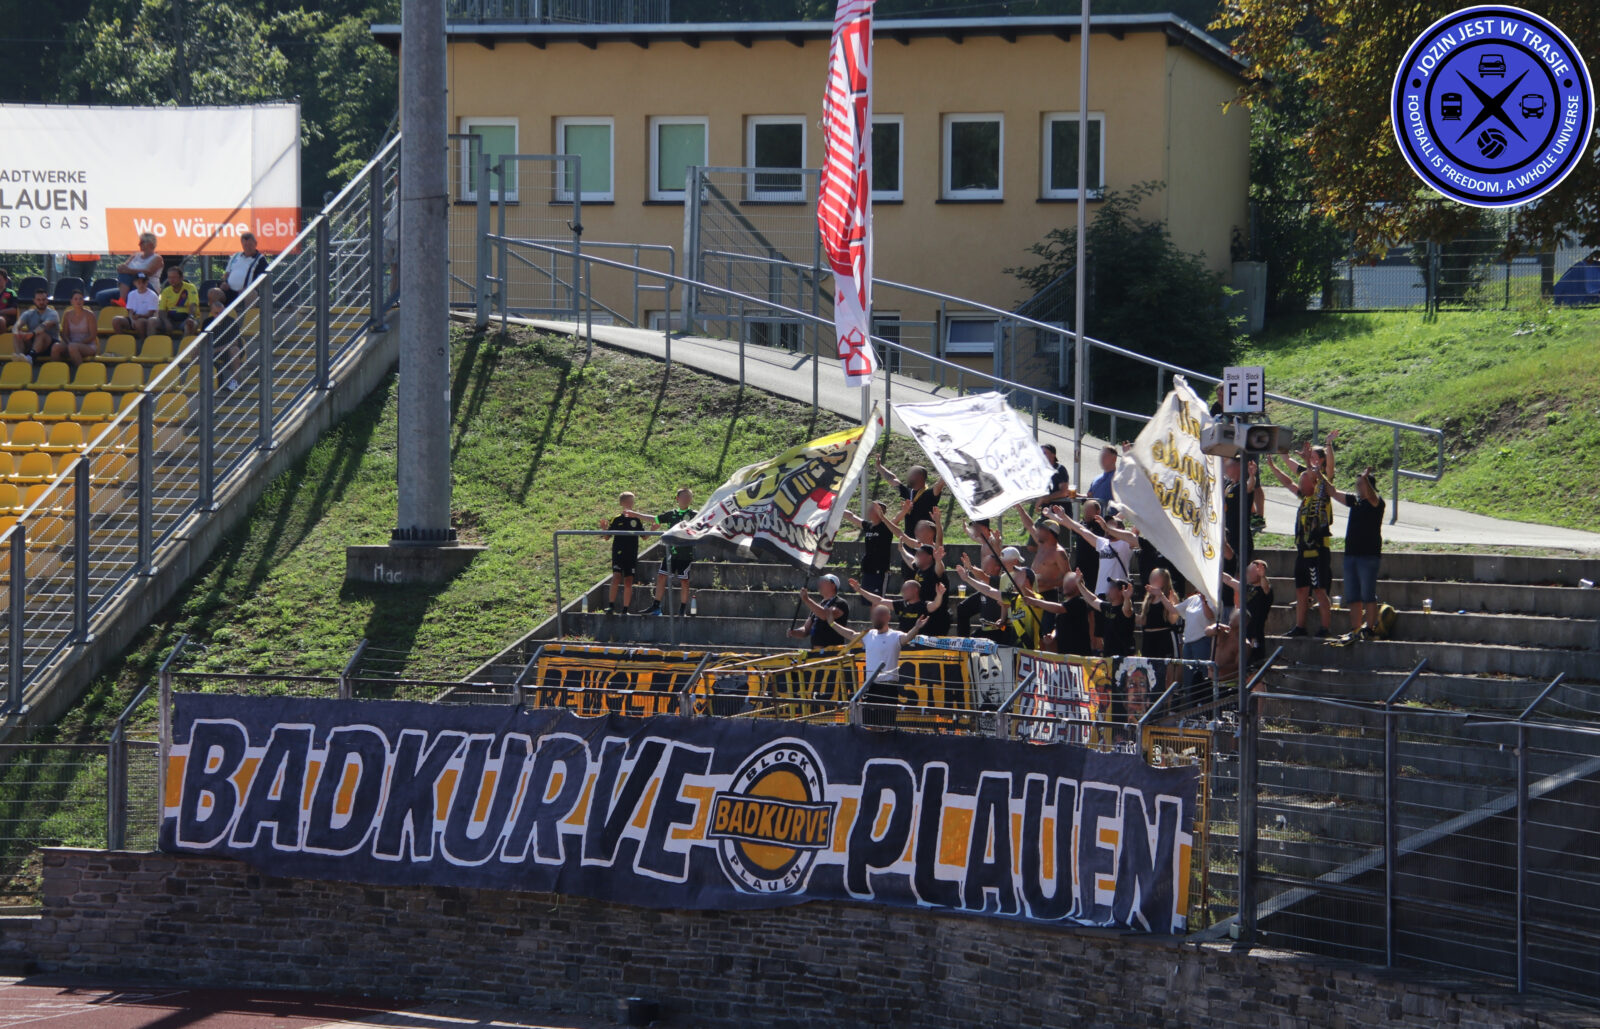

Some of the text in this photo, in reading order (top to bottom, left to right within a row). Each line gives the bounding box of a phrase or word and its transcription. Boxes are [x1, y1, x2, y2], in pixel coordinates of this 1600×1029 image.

[133, 218, 167, 238] Wo
[172, 218, 249, 238] Wärme
[1245, 372, 1259, 380] Block
[1228, 382, 1239, 406] F
[1247, 382, 1258, 405] E
[746, 751, 818, 788] BLOCK F
[176, 718, 1183, 935] BADKURVE PLAUEN
[714, 799, 829, 843] BADKURVE
[730, 854, 801, 892] PLAUEN
